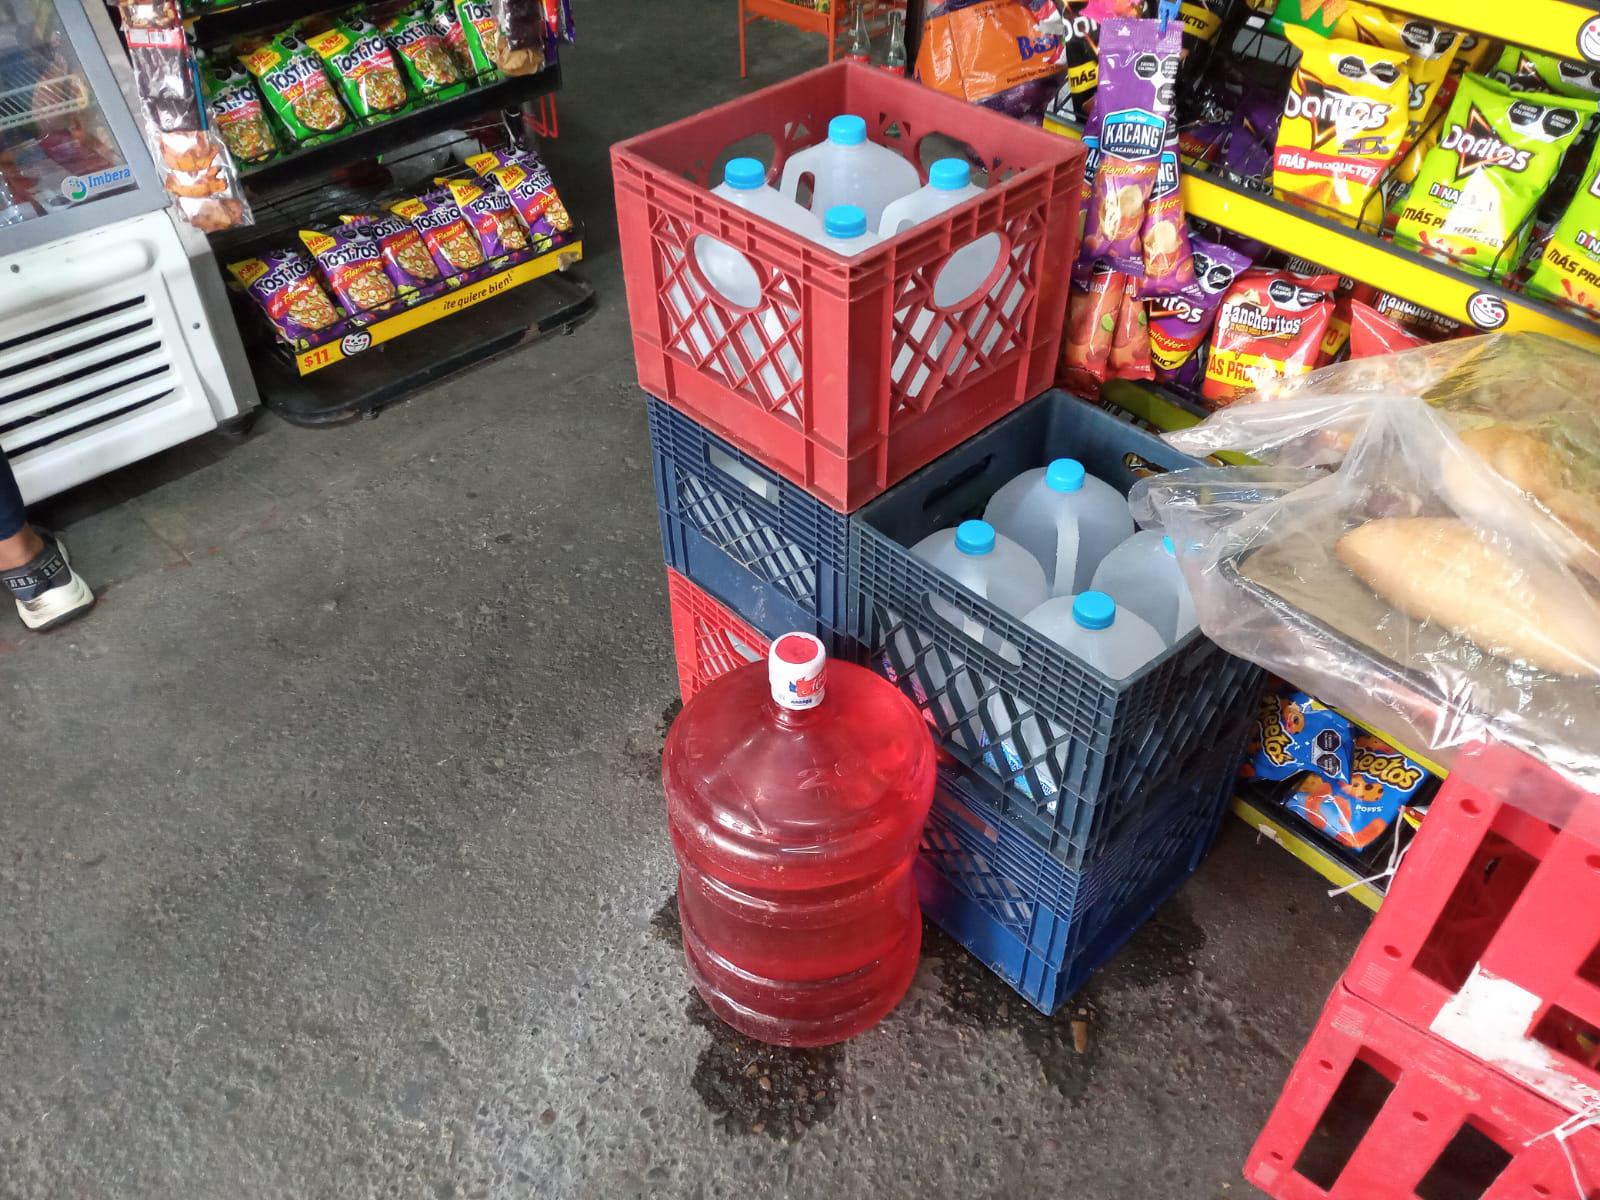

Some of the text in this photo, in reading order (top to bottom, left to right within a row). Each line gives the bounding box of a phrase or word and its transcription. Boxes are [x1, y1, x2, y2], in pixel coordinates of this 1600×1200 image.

[1284, 88, 1388, 129] Doritos
[1441, 124, 1531, 172] Doritos
[88, 168, 131, 188] Imbera
[1402, 208, 1433, 225] MÁS
[1547, 248, 1580, 274] MÁS
[457, 290, 488, 310] quiere
[489, 274, 513, 295] bien!
[1219, 303, 1301, 334] Rancheritos
[304, 349, 329, 368] $11
